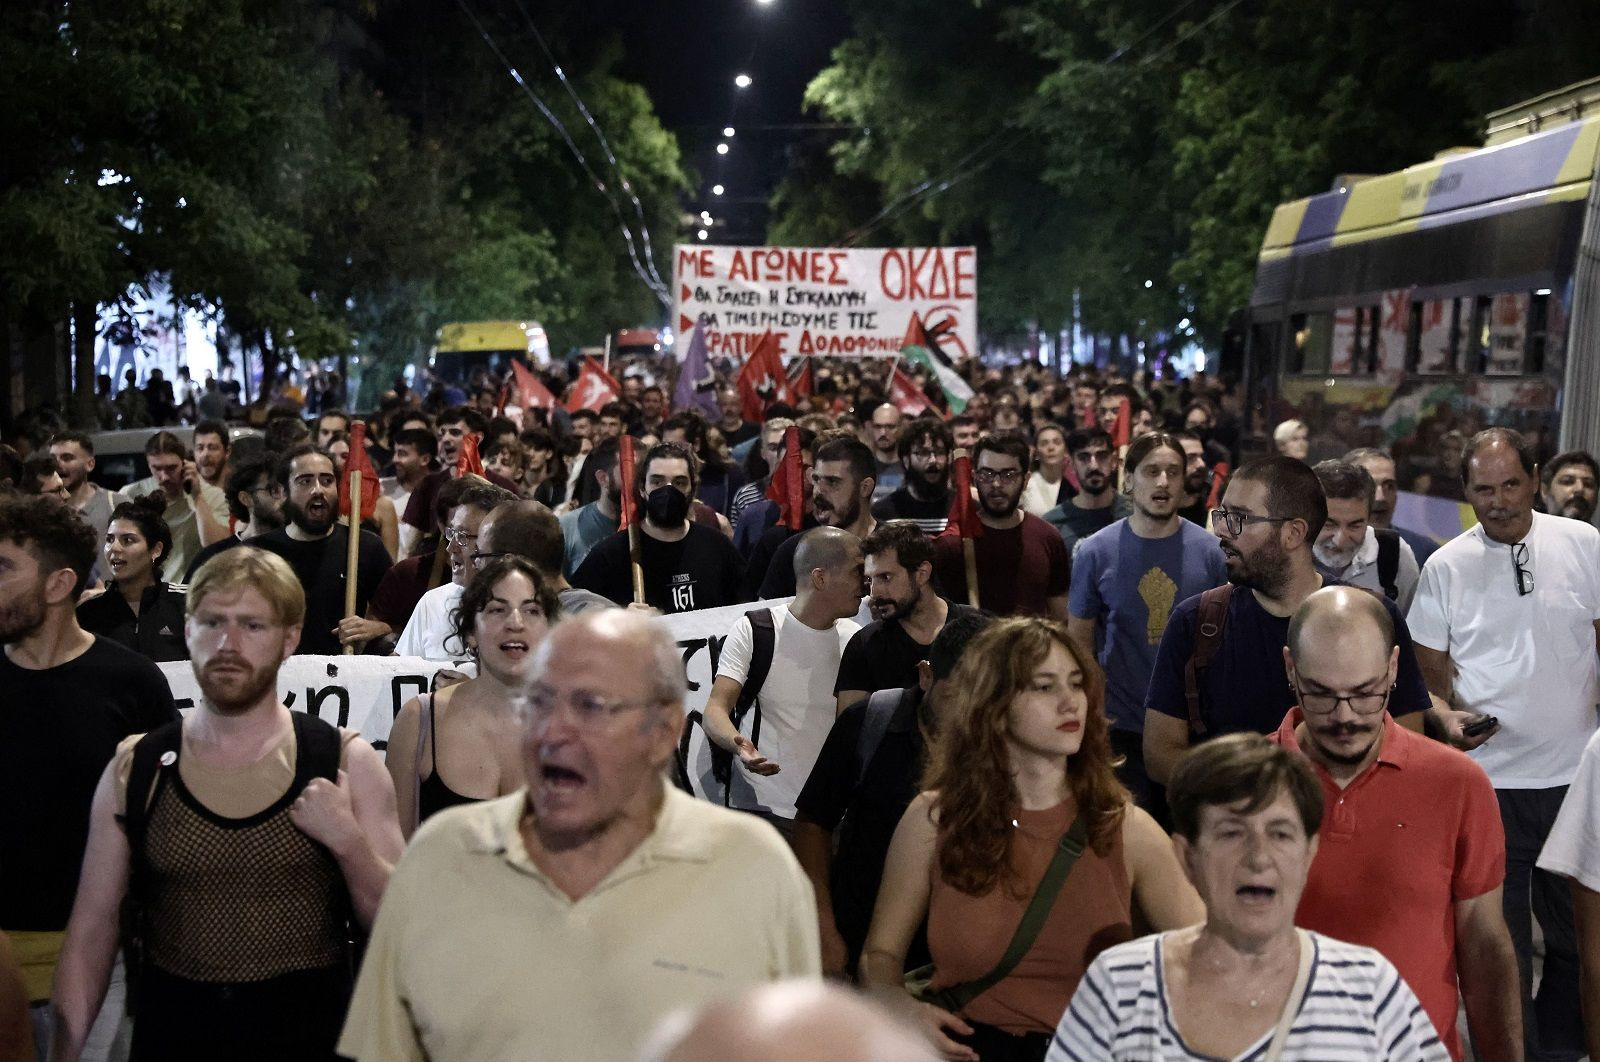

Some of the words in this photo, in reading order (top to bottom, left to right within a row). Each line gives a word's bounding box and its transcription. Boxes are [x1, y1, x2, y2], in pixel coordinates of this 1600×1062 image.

[678, 249, 715, 278] ΜΕ
[880, 247, 975, 301] ΟΚΔΕ
[694, 285, 712, 303] ΘΑ
[717, 285, 761, 306] ΣΠΑΣΕΙ
[769, 289, 779, 304] Η
[847, 311, 878, 330] ΤΙΣ
[672, 584, 695, 611] 161
